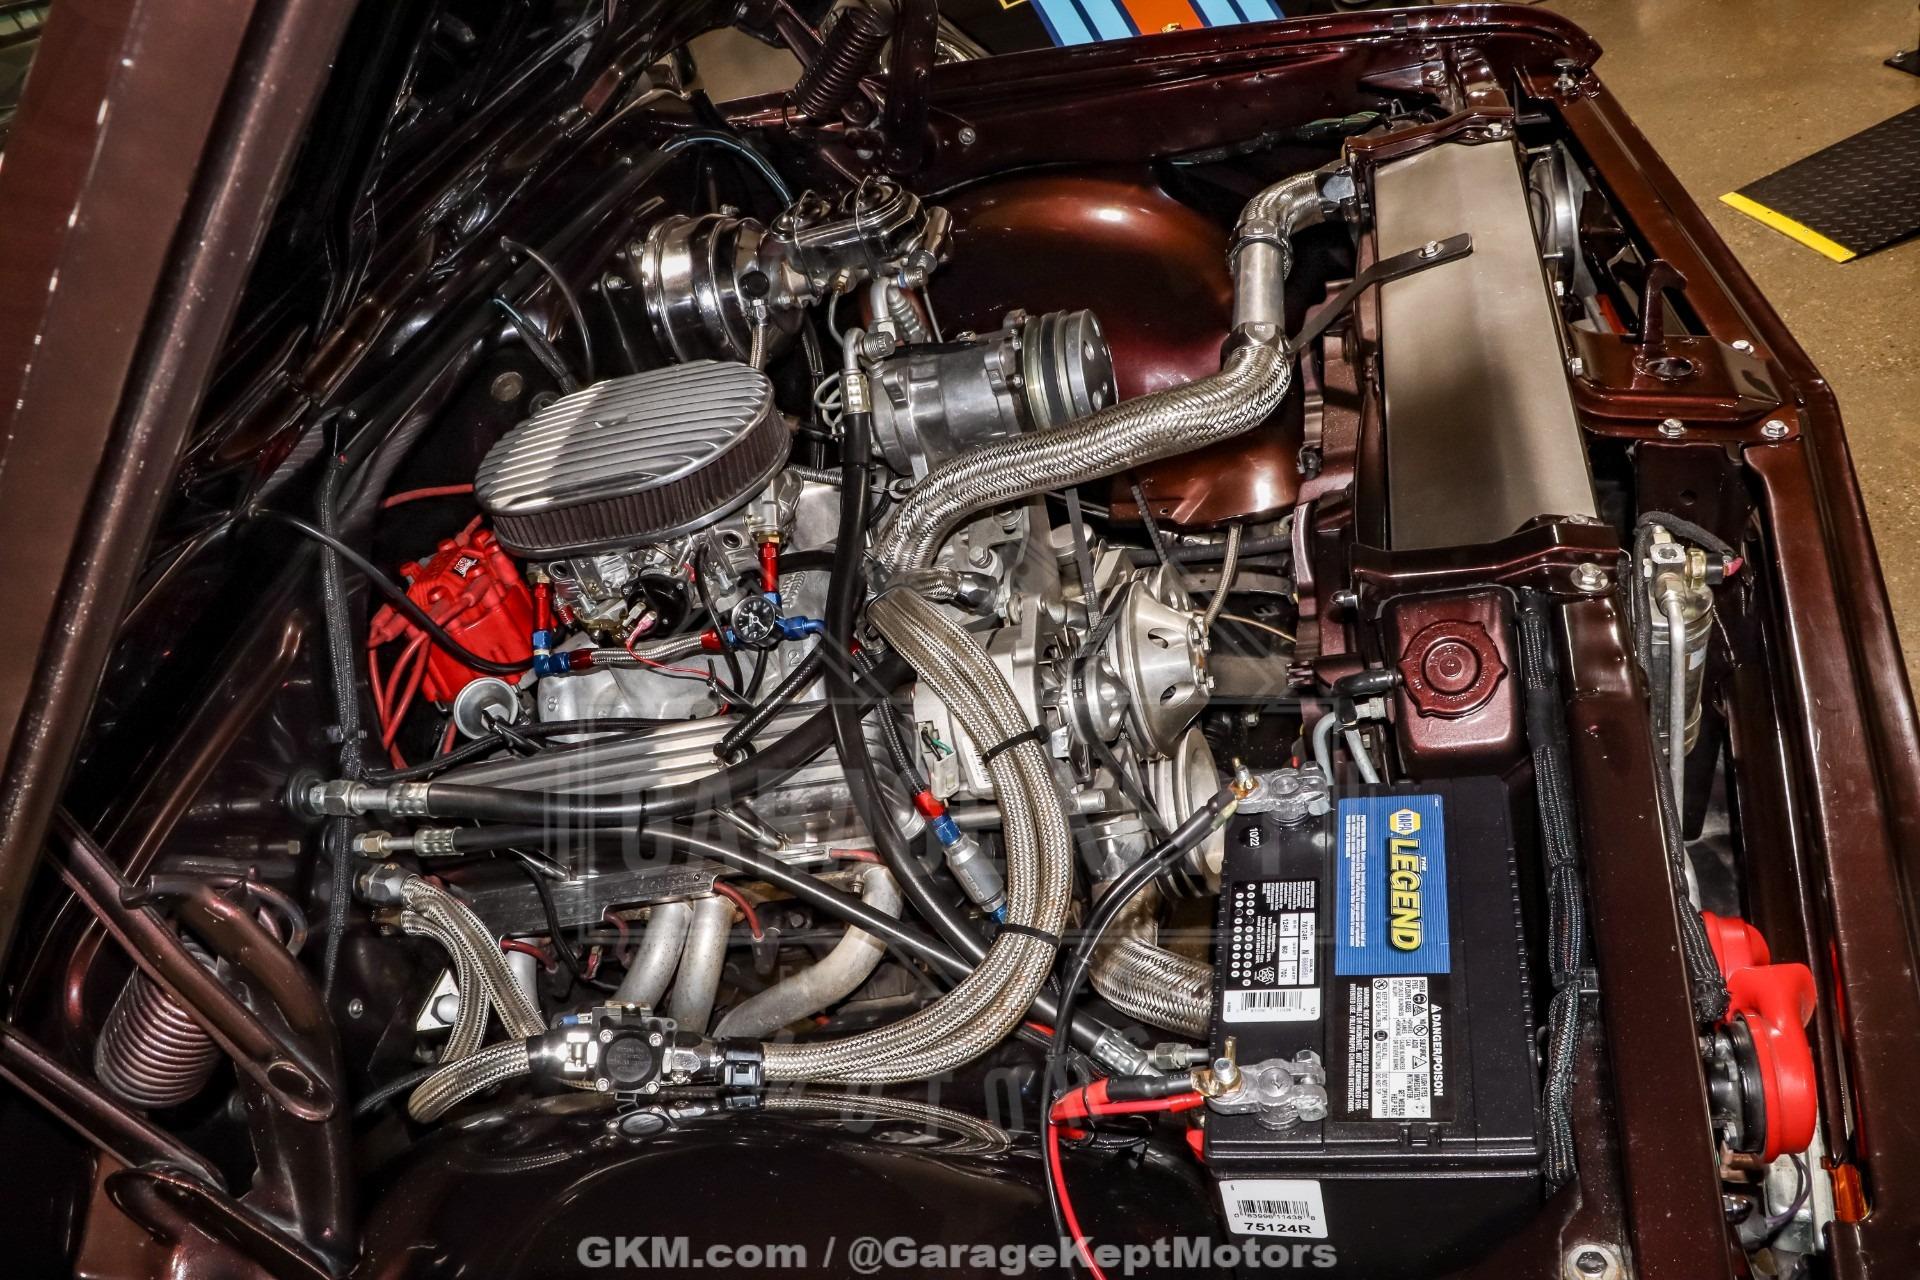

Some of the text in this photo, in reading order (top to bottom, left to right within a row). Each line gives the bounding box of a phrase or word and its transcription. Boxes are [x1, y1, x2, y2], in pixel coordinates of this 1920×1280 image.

[1398, 814, 1412, 832] NAPA
[1248, 828, 1260, 847] 10/22
[1389, 838, 1422, 952] LEGEND
[1432, 1014, 1443, 1096] DANGER/POISON
[1244, 1222, 1312, 1234] 75124R
